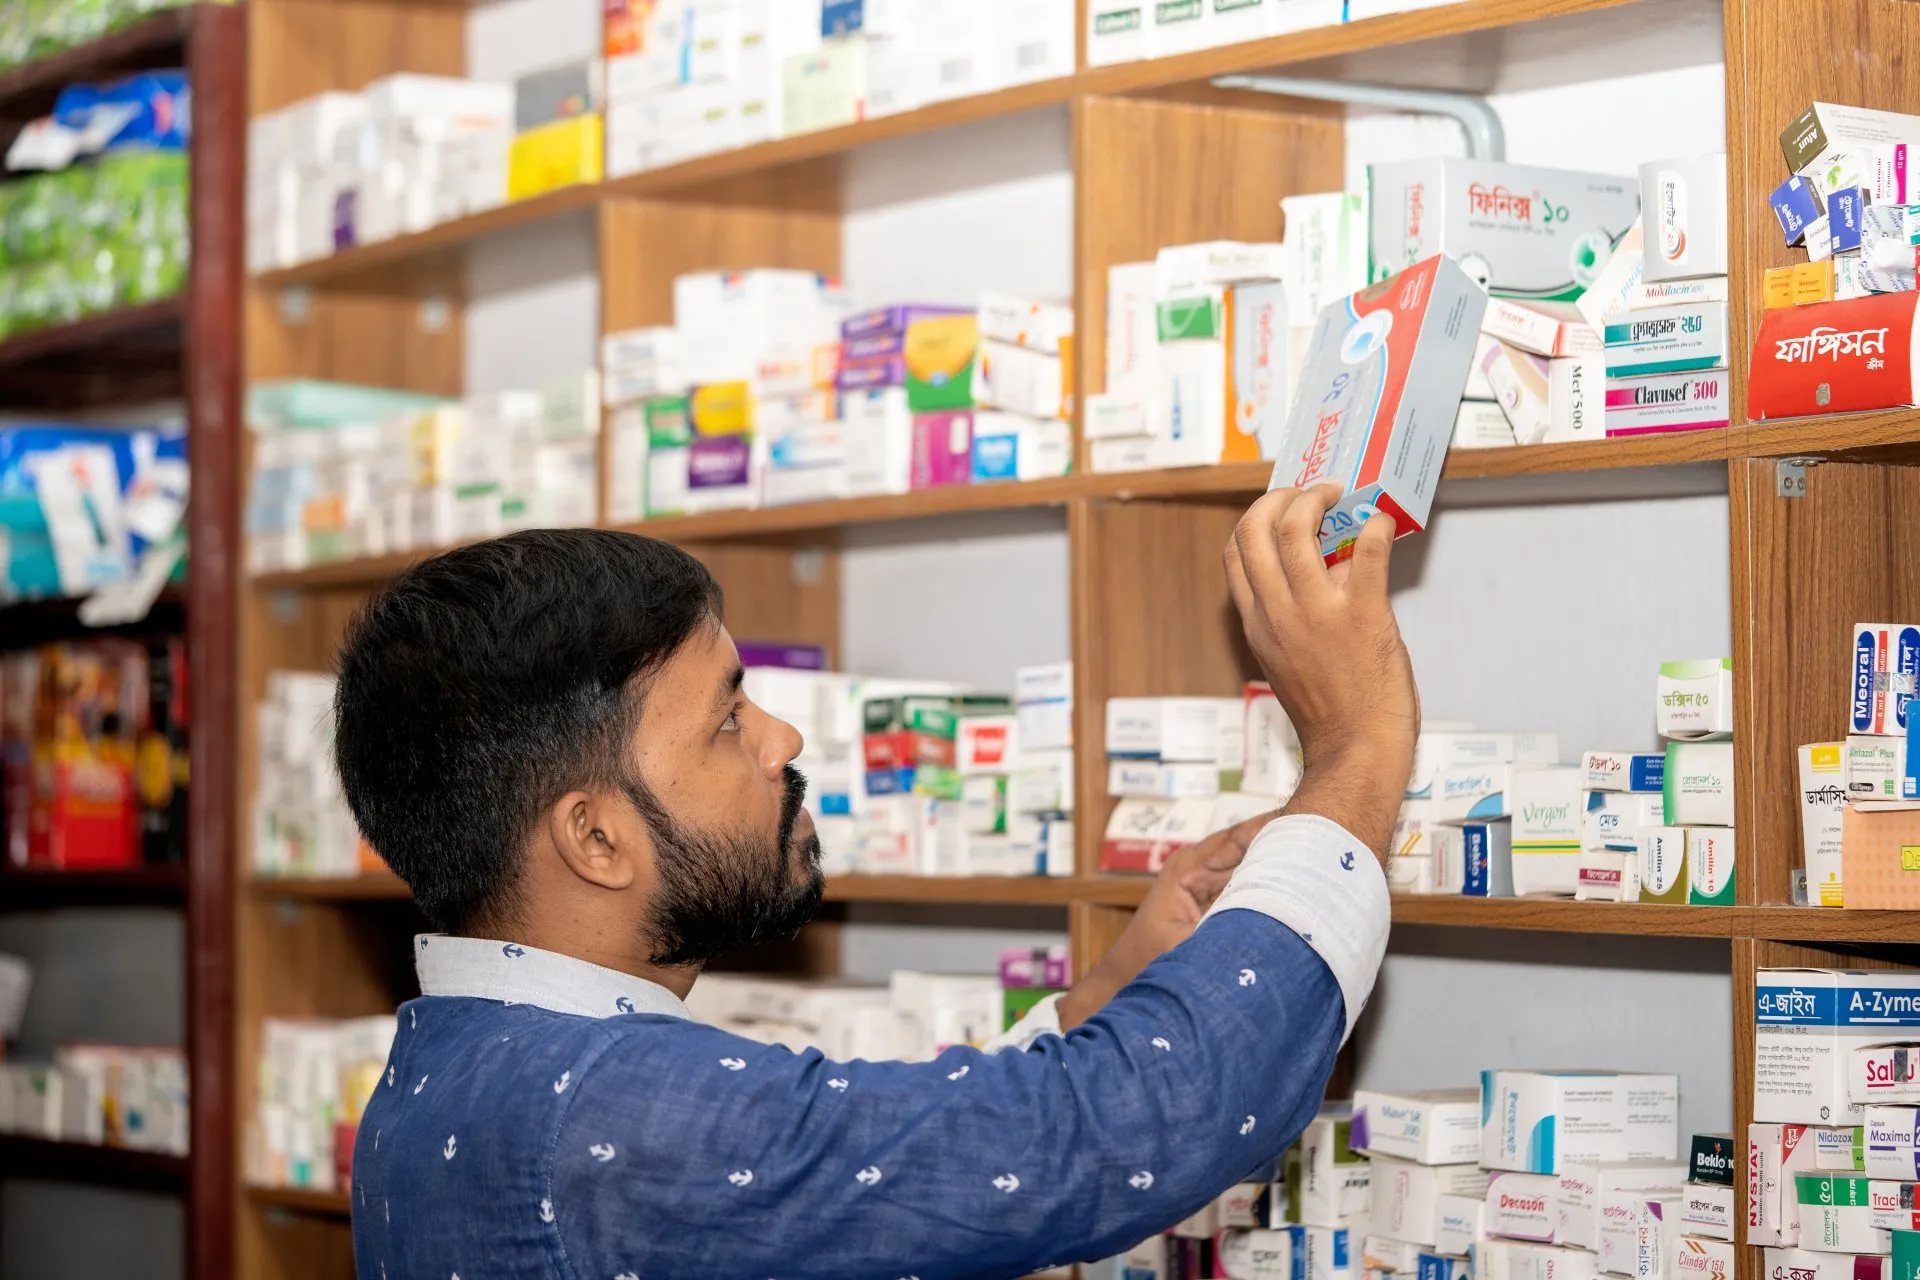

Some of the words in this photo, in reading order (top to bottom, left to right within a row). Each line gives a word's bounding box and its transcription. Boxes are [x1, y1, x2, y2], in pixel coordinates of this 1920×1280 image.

[1799, 127, 1819, 151] Afun
[1468, 183, 1532, 223] ফিনিক্স
[1543, 199, 1569, 223] ১০
[1645, 284, 1690, 298] Moxilocin
[1681, 315, 1703, 334] ২৫০
[1775, 326, 1889, 364] ফাঙ্গিসন
[1572, 365, 1582, 394] Met
[1634, 381, 1689, 405] Clavusef
[1693, 379, 1719, 401] 500
[1571, 401, 1583, 430] 500
[1325, 511, 1353, 532] 20
[1854, 647, 1870, 719] Meoral
[1695, 692, 1709, 706] ৫০
[1879, 748, 1895, 759] Plus
[1522, 804, 1567, 829] Vergon
[1707, 838, 1715, 875] Amilin
[1656, 876, 1663, 890] 25
[1707, 878, 1714, 892] 10
[1758, 987, 1816, 1016] এ-জাইম
[1818, 1132, 1852, 1143] Nidozox
[1870, 1129, 1911, 1142] Maxima
[1696, 1152, 1725, 1169] Beklo
[1749, 1140, 1758, 1227] NYSTAT
[1819, 1181, 1831, 1203] ৫০
[1711, 1260, 1725, 1272] 150
